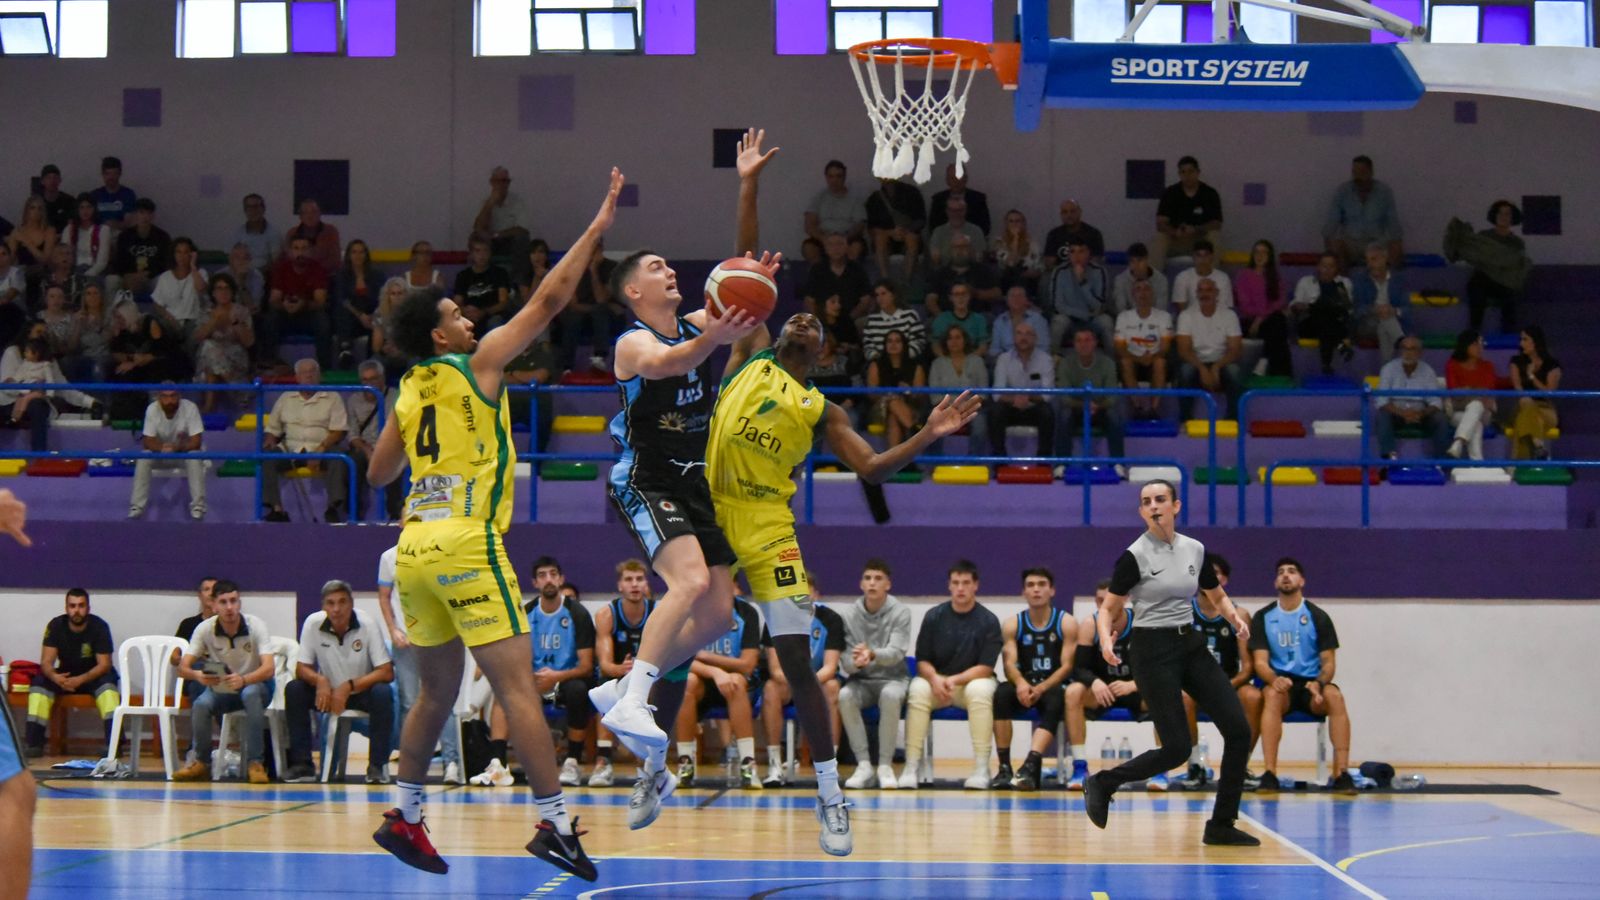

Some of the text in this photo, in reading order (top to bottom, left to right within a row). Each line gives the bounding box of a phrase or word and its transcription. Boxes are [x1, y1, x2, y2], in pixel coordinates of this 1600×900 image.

[1111, 58, 1310, 83] SPORT SYSTEM
[415, 404, 440, 464] 4
[732, 416, 782, 454] Jaén
[778, 569, 793, 580] LZ
[448, 594, 490, 609] Blanca
